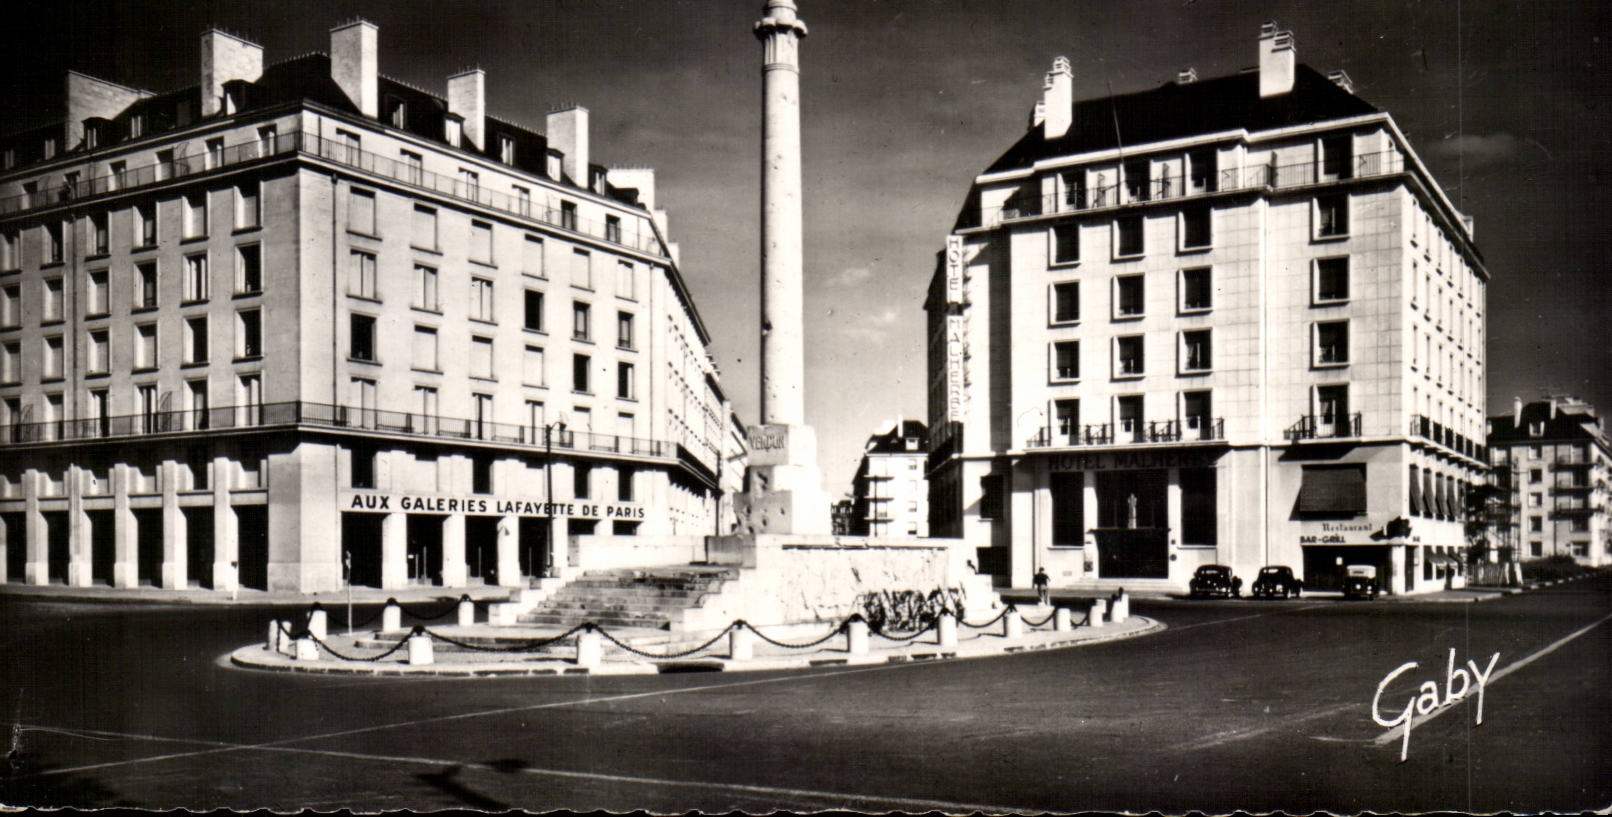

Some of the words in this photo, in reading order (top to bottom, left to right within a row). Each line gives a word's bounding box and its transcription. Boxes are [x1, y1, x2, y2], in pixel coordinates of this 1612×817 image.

[1048, 453, 1106, 471] HOTEL
[351, 494, 390, 510] AUX
[401, 496, 487, 513] GALERIES
[497, 501, 574, 516] LAFAYETTE
[582, 504, 599, 517] DE
[607, 506, 645, 519] PARIS
[1322, 523, 1373, 532] Restaurant
